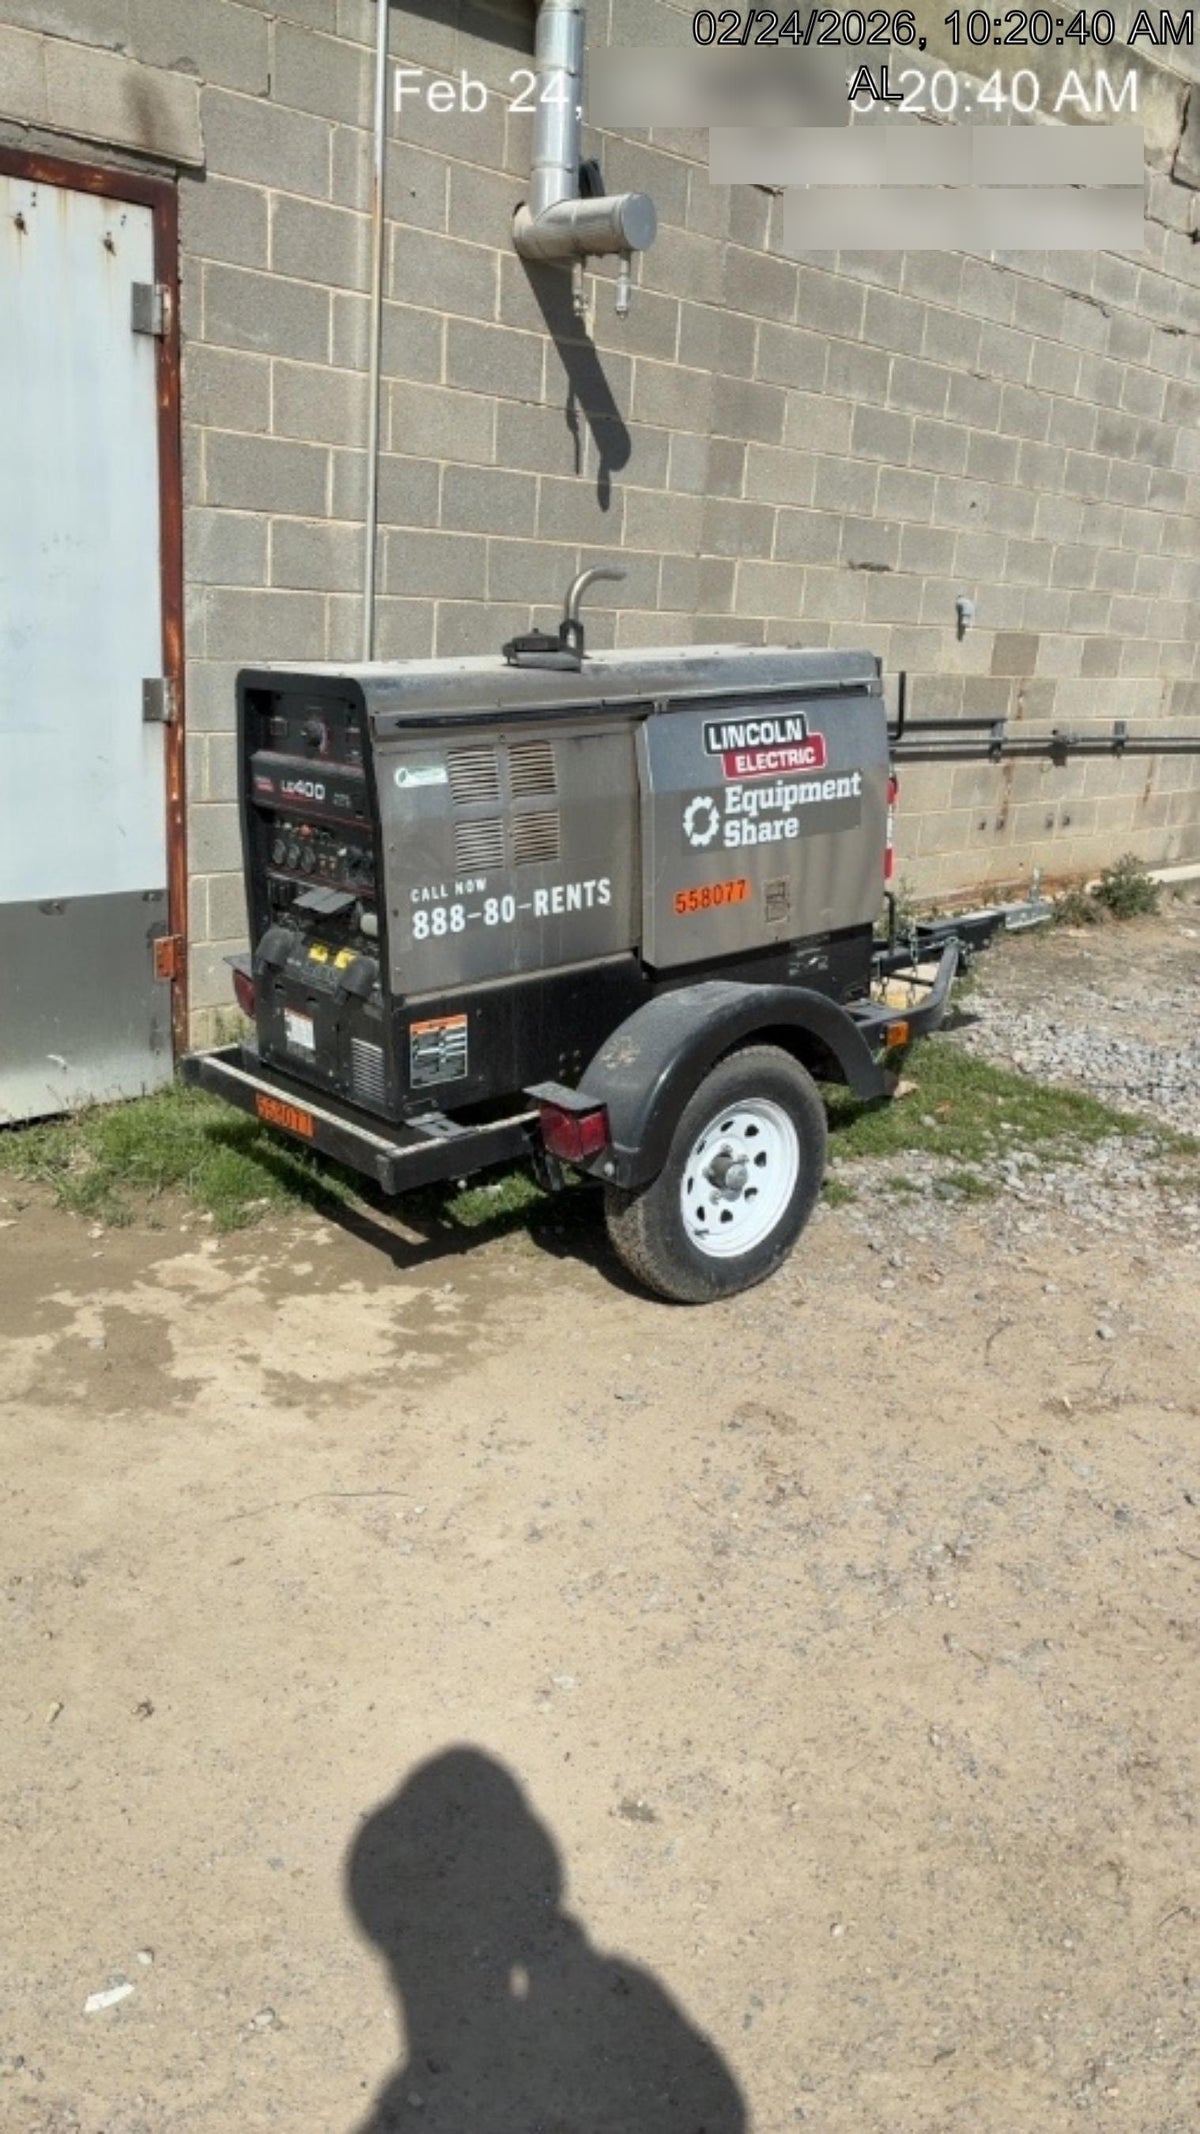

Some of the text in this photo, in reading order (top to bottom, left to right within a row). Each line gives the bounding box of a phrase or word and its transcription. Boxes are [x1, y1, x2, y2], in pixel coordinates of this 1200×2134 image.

[706, 717, 804, 751] LINCOLN
[734, 746, 817, 774] ELECTRIC
[724, 771, 862, 817] Equipment
[723, 816, 800, 848] Share
[410, 877, 487, 902] CALL NOW
[675, 879, 746, 914] 558077
[412, 877, 612, 940] 888-80-RENTS
